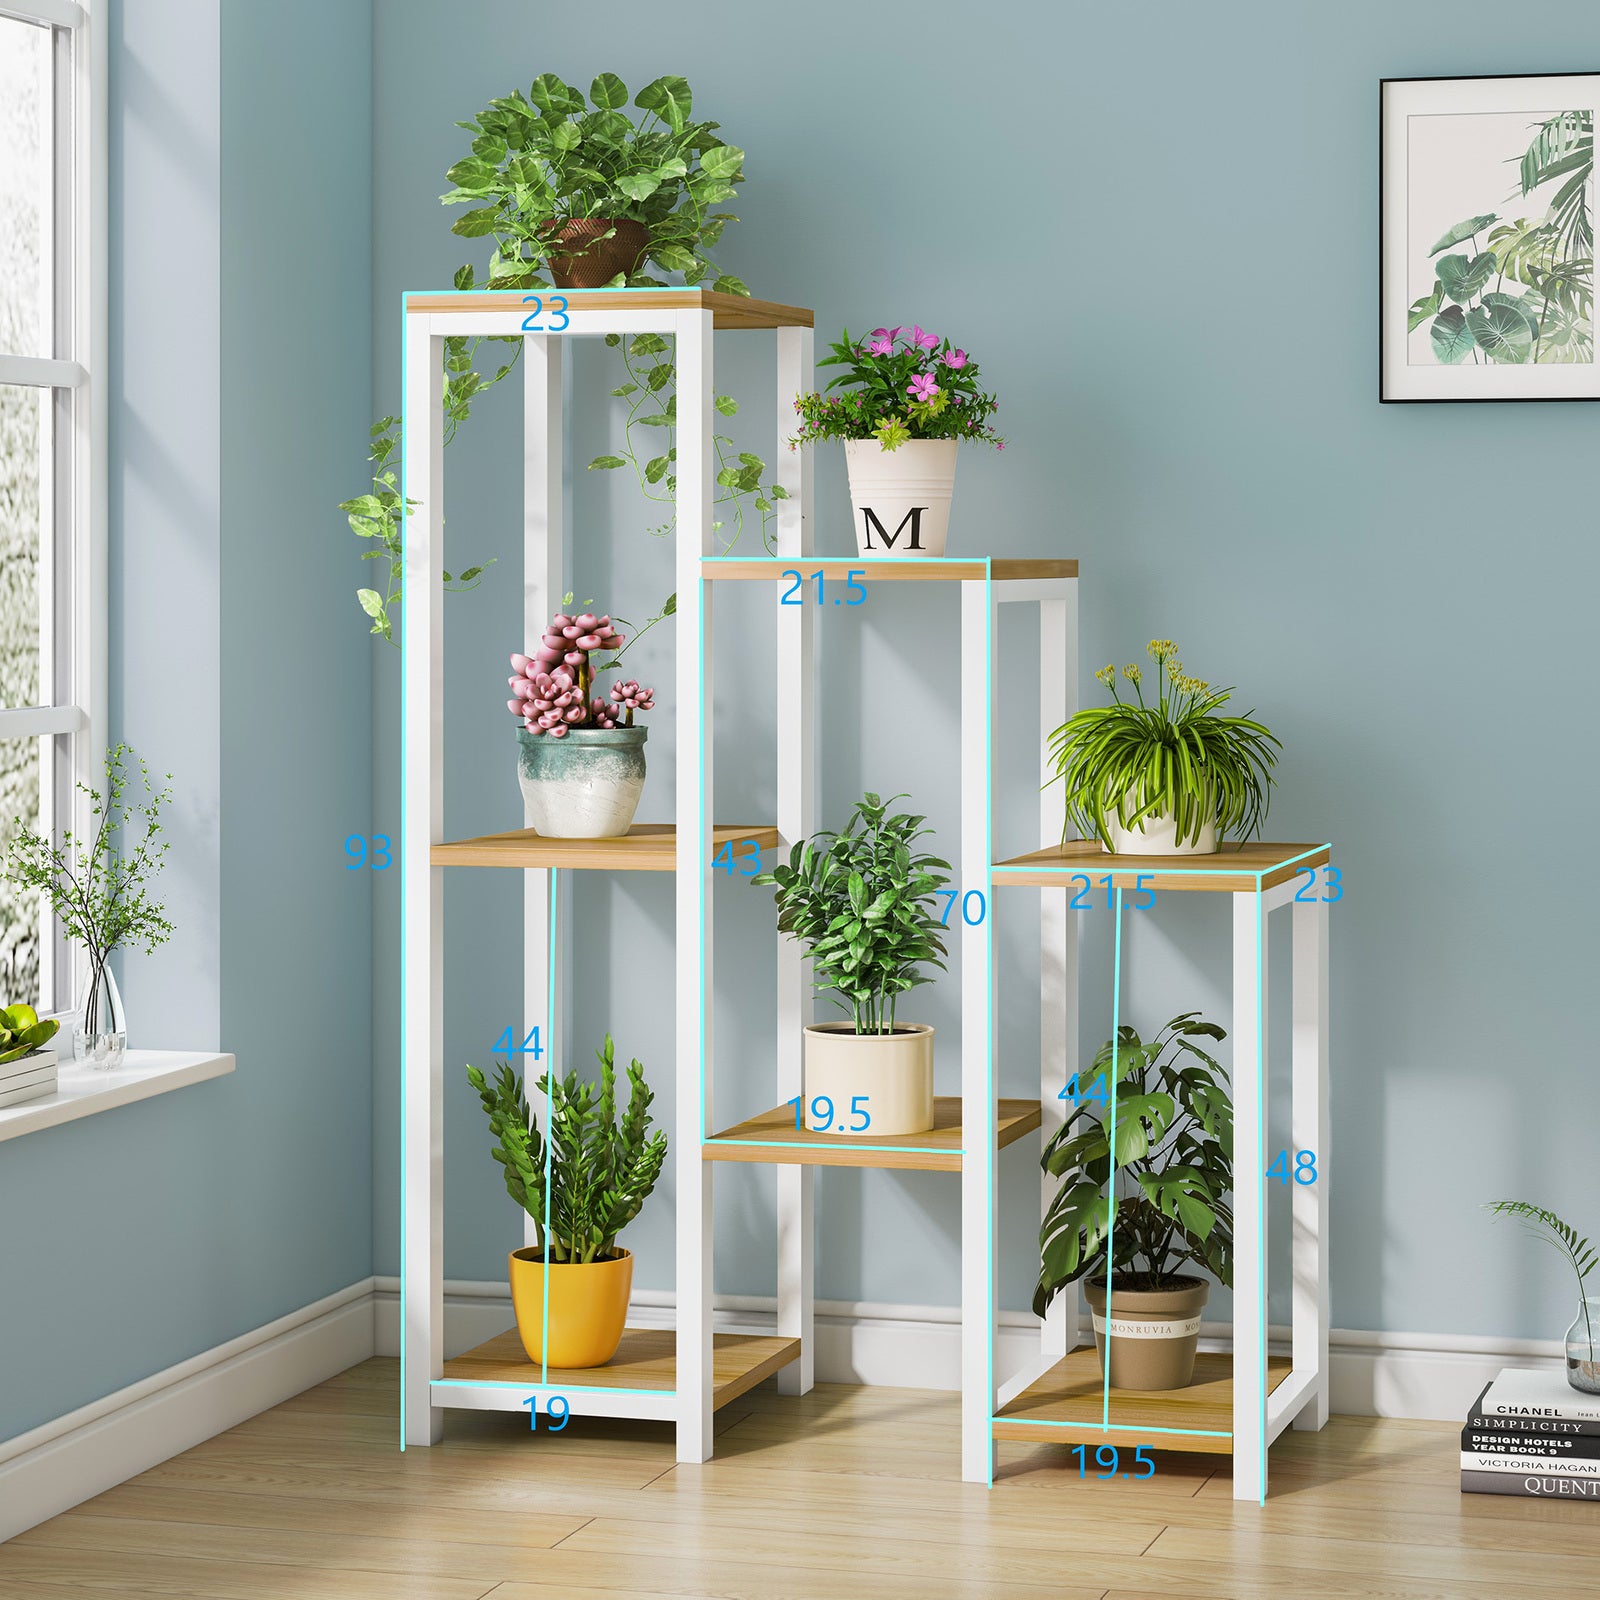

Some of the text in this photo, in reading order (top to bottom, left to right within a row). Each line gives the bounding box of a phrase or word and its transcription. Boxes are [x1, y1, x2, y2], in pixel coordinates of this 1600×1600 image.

[859, 507, 929, 550] M
[1111, 1323, 1172, 1334] MONRUVIA
[1496, 1405, 1562, 1417] CHANEL
[1473, 1418, 1582, 1433] SIMPLICITY
[1472, 1435, 1573, 1448] DESIGN HOTELS
[1472, 1443, 1506, 1452] YEAR
[1509, 1446, 1546, 1455] BOOK
[1479, 1459, 1597, 1473] VICTORIA HAGAN
[1524, 1477, 1600, 1496] QUENT
